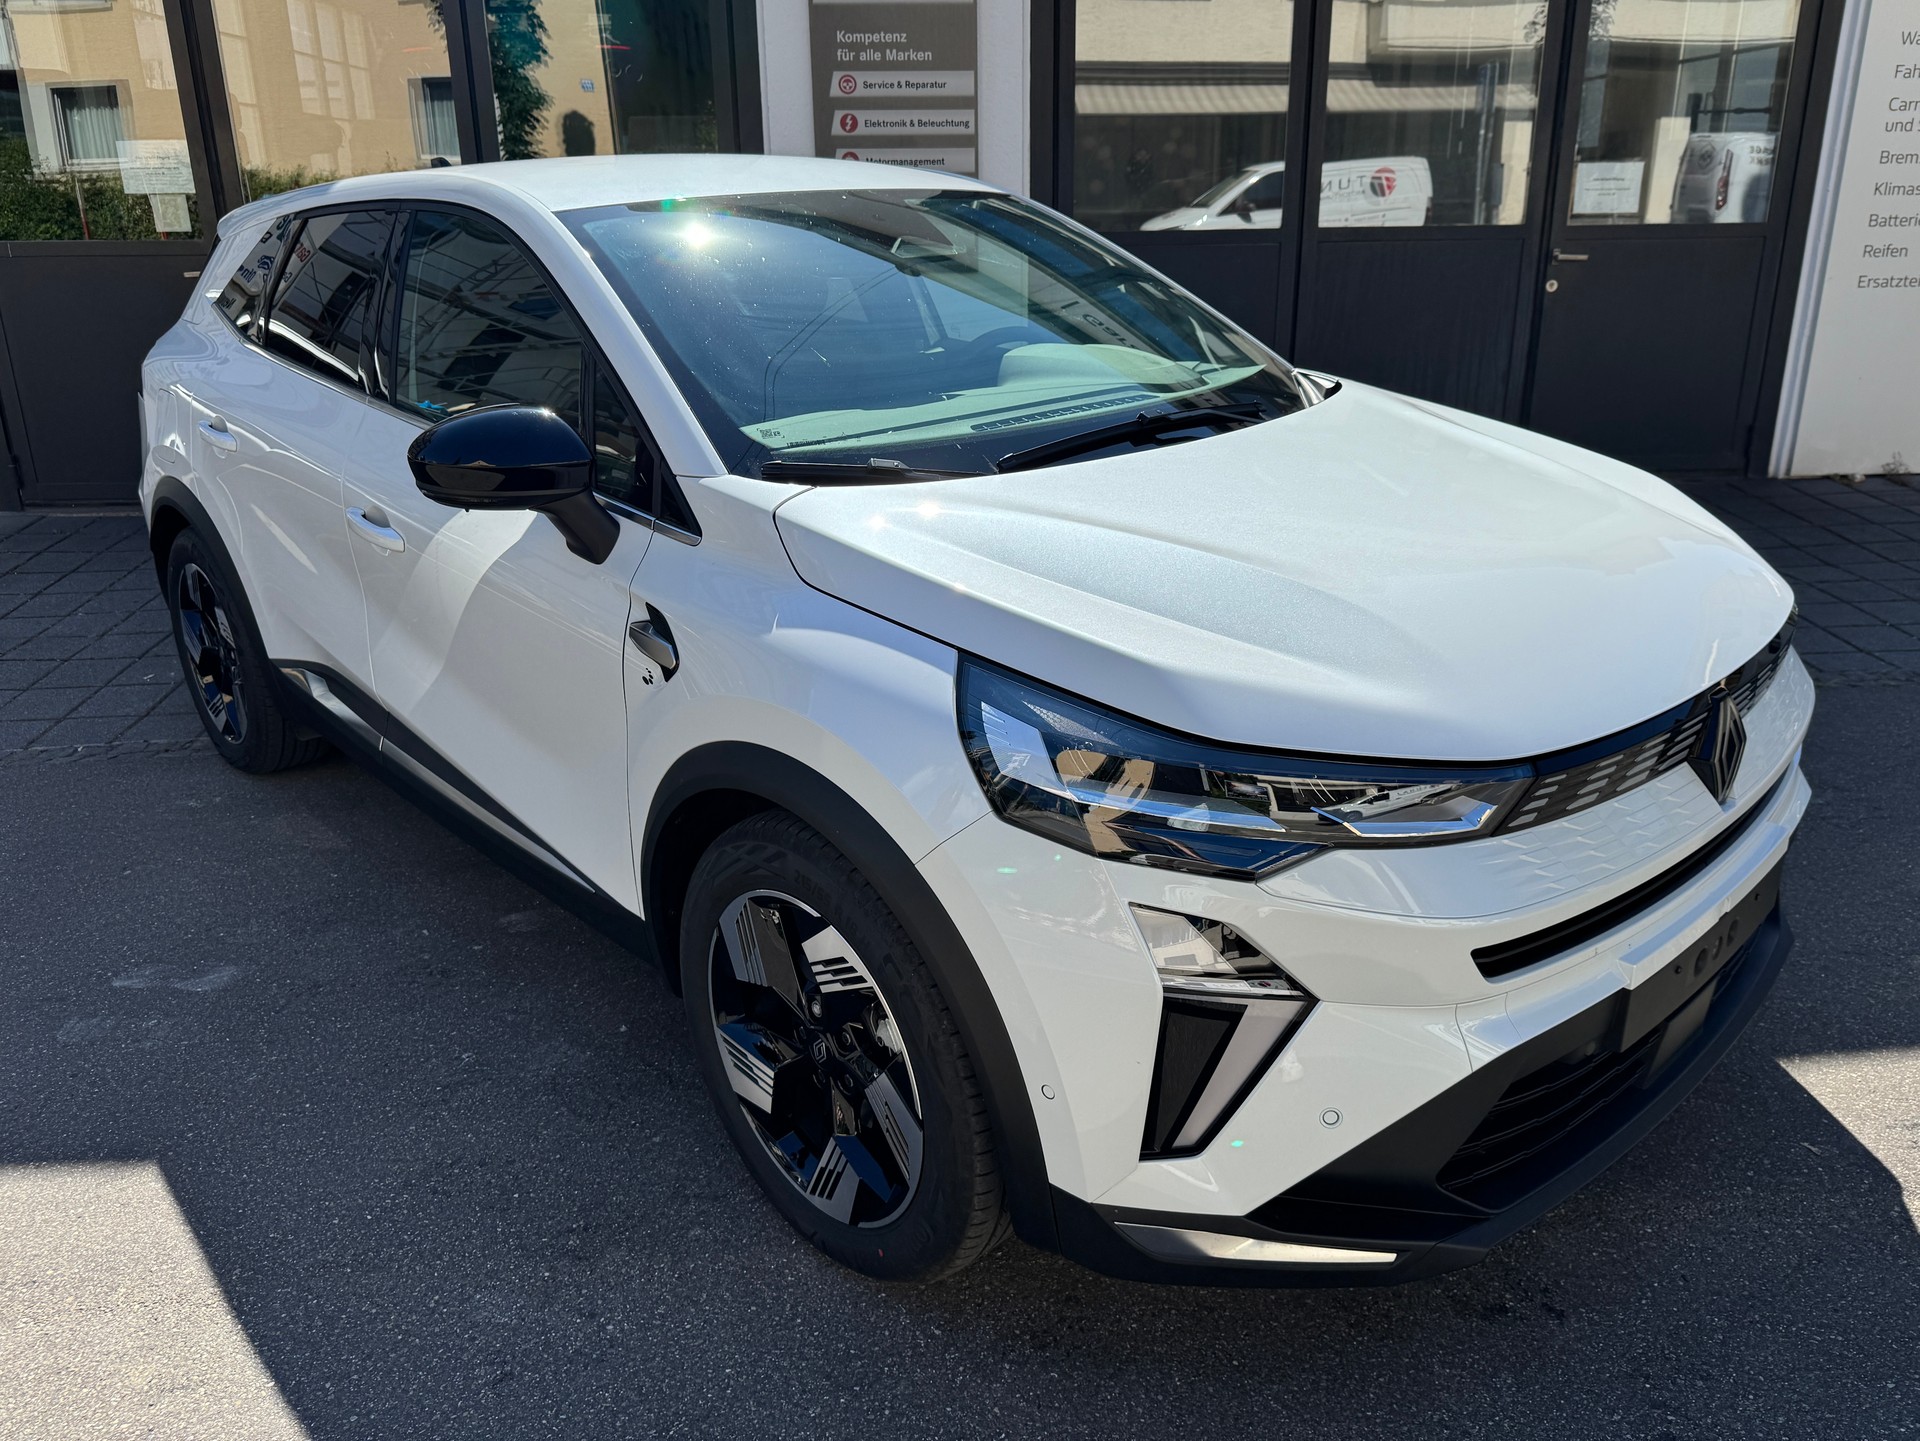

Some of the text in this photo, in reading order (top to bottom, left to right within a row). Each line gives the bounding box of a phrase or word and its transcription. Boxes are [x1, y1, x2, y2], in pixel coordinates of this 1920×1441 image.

[836, 30, 907, 45] Kompetenz
[836, 49, 932, 61] für alle Marken
[1894, 63, 1920, 79] Fah
[863, 80, 947, 90] Service & Reparatur
[864, 119, 970, 129] Elektronik & Beleuchtung
[1885, 117, 1914, 132] und
[1879, 150, 1920, 164] Brem
[1873, 182, 1920, 196] Klimas
[1868, 213, 1920, 228] Batteri
[1862, 243, 1909, 258] Reifen
